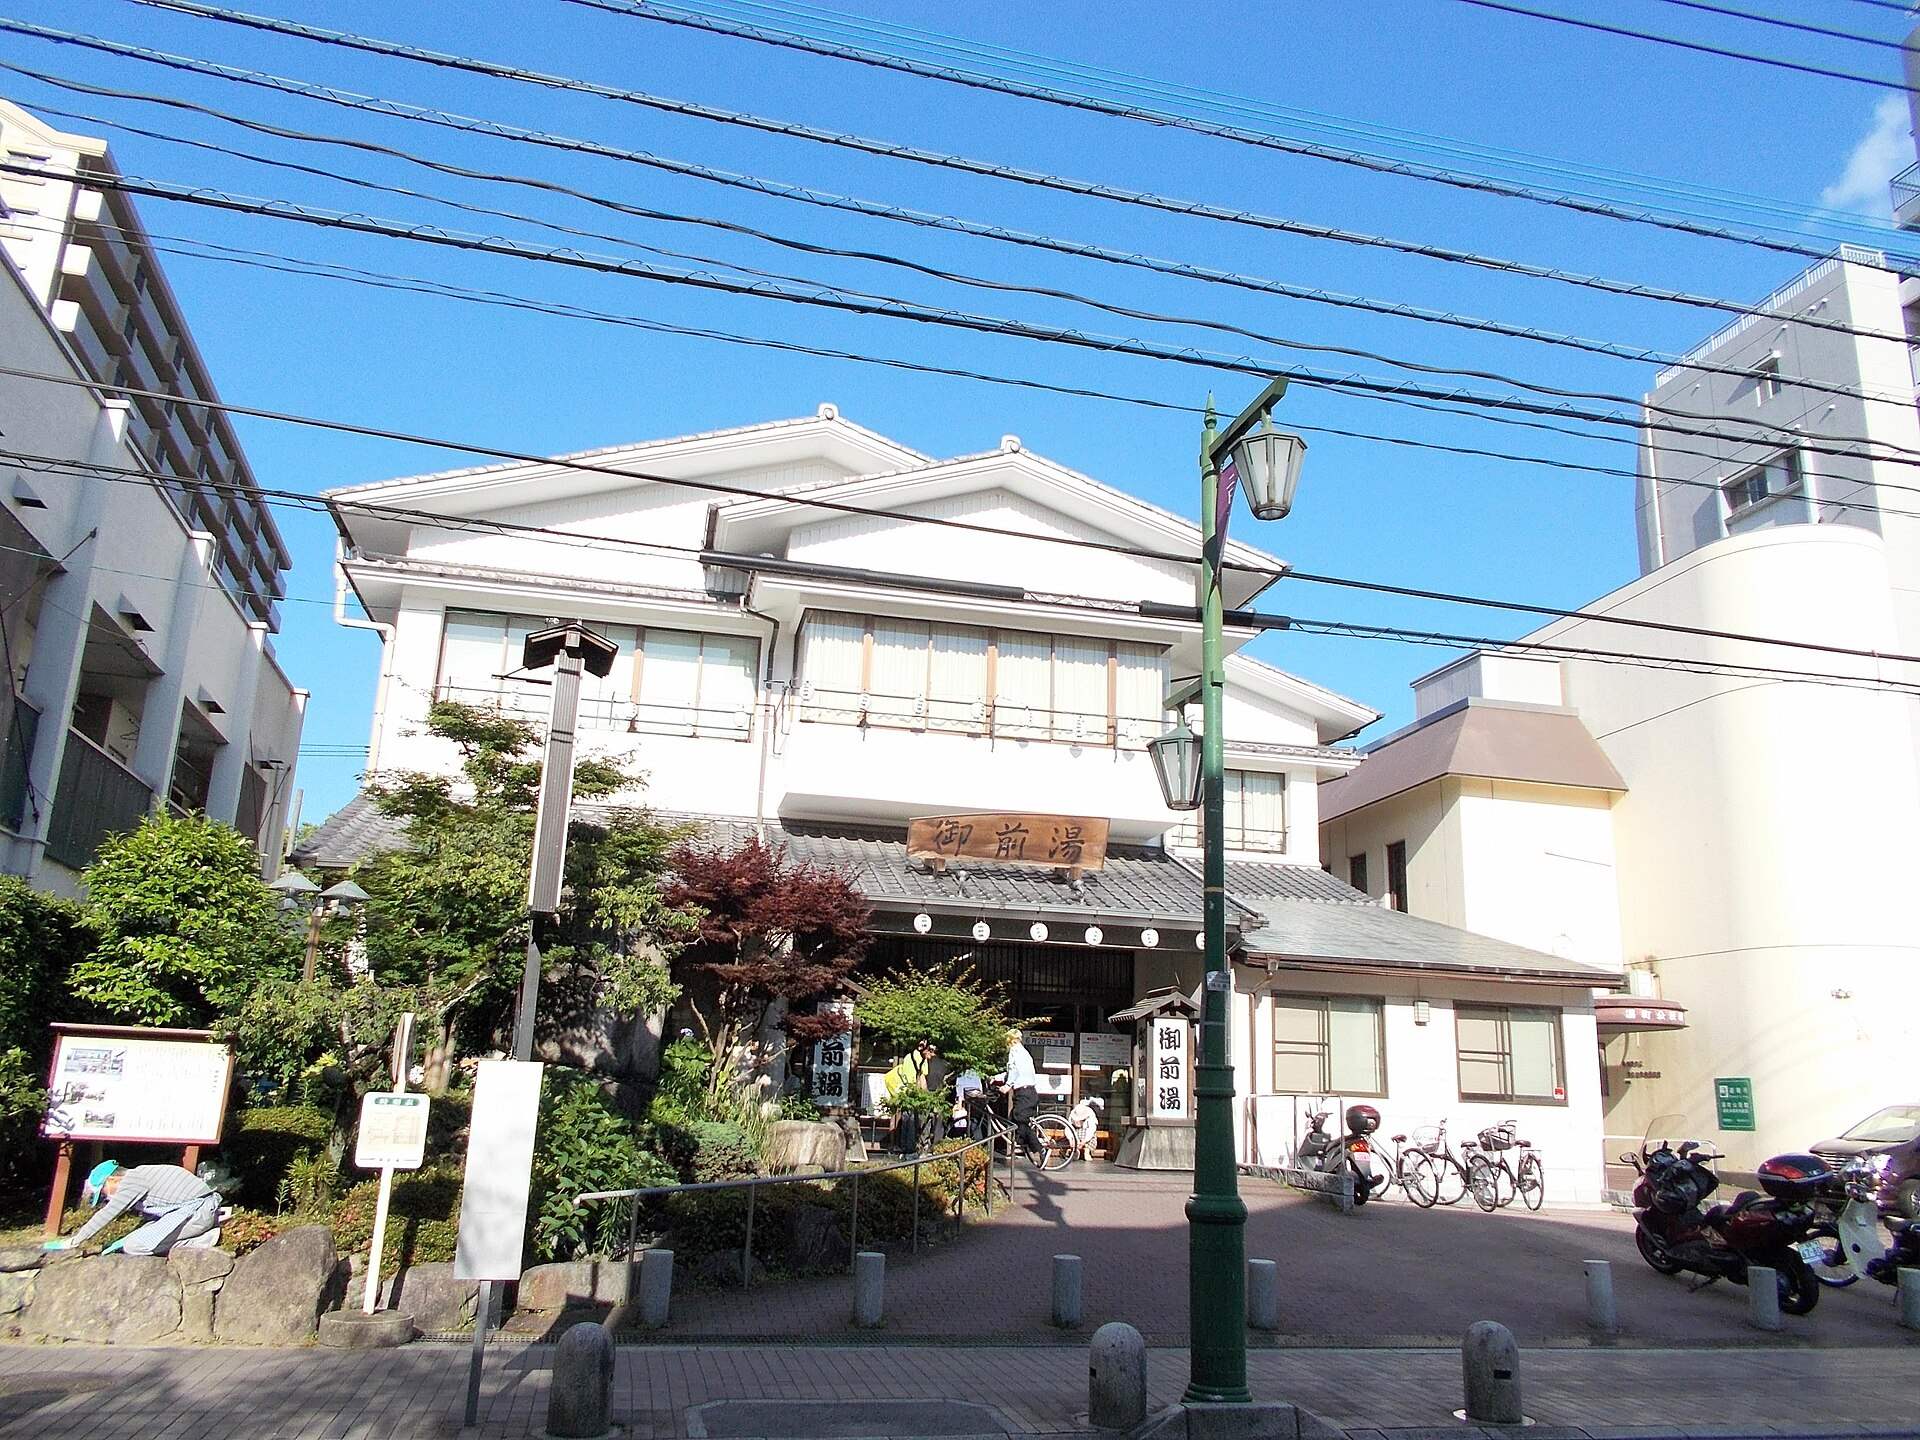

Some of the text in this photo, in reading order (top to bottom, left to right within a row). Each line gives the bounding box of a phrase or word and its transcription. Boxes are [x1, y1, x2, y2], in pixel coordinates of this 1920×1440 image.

[934, 819, 1085, 865] 御前湯
[1159, 1026, 1181, 1110] 御前湯
